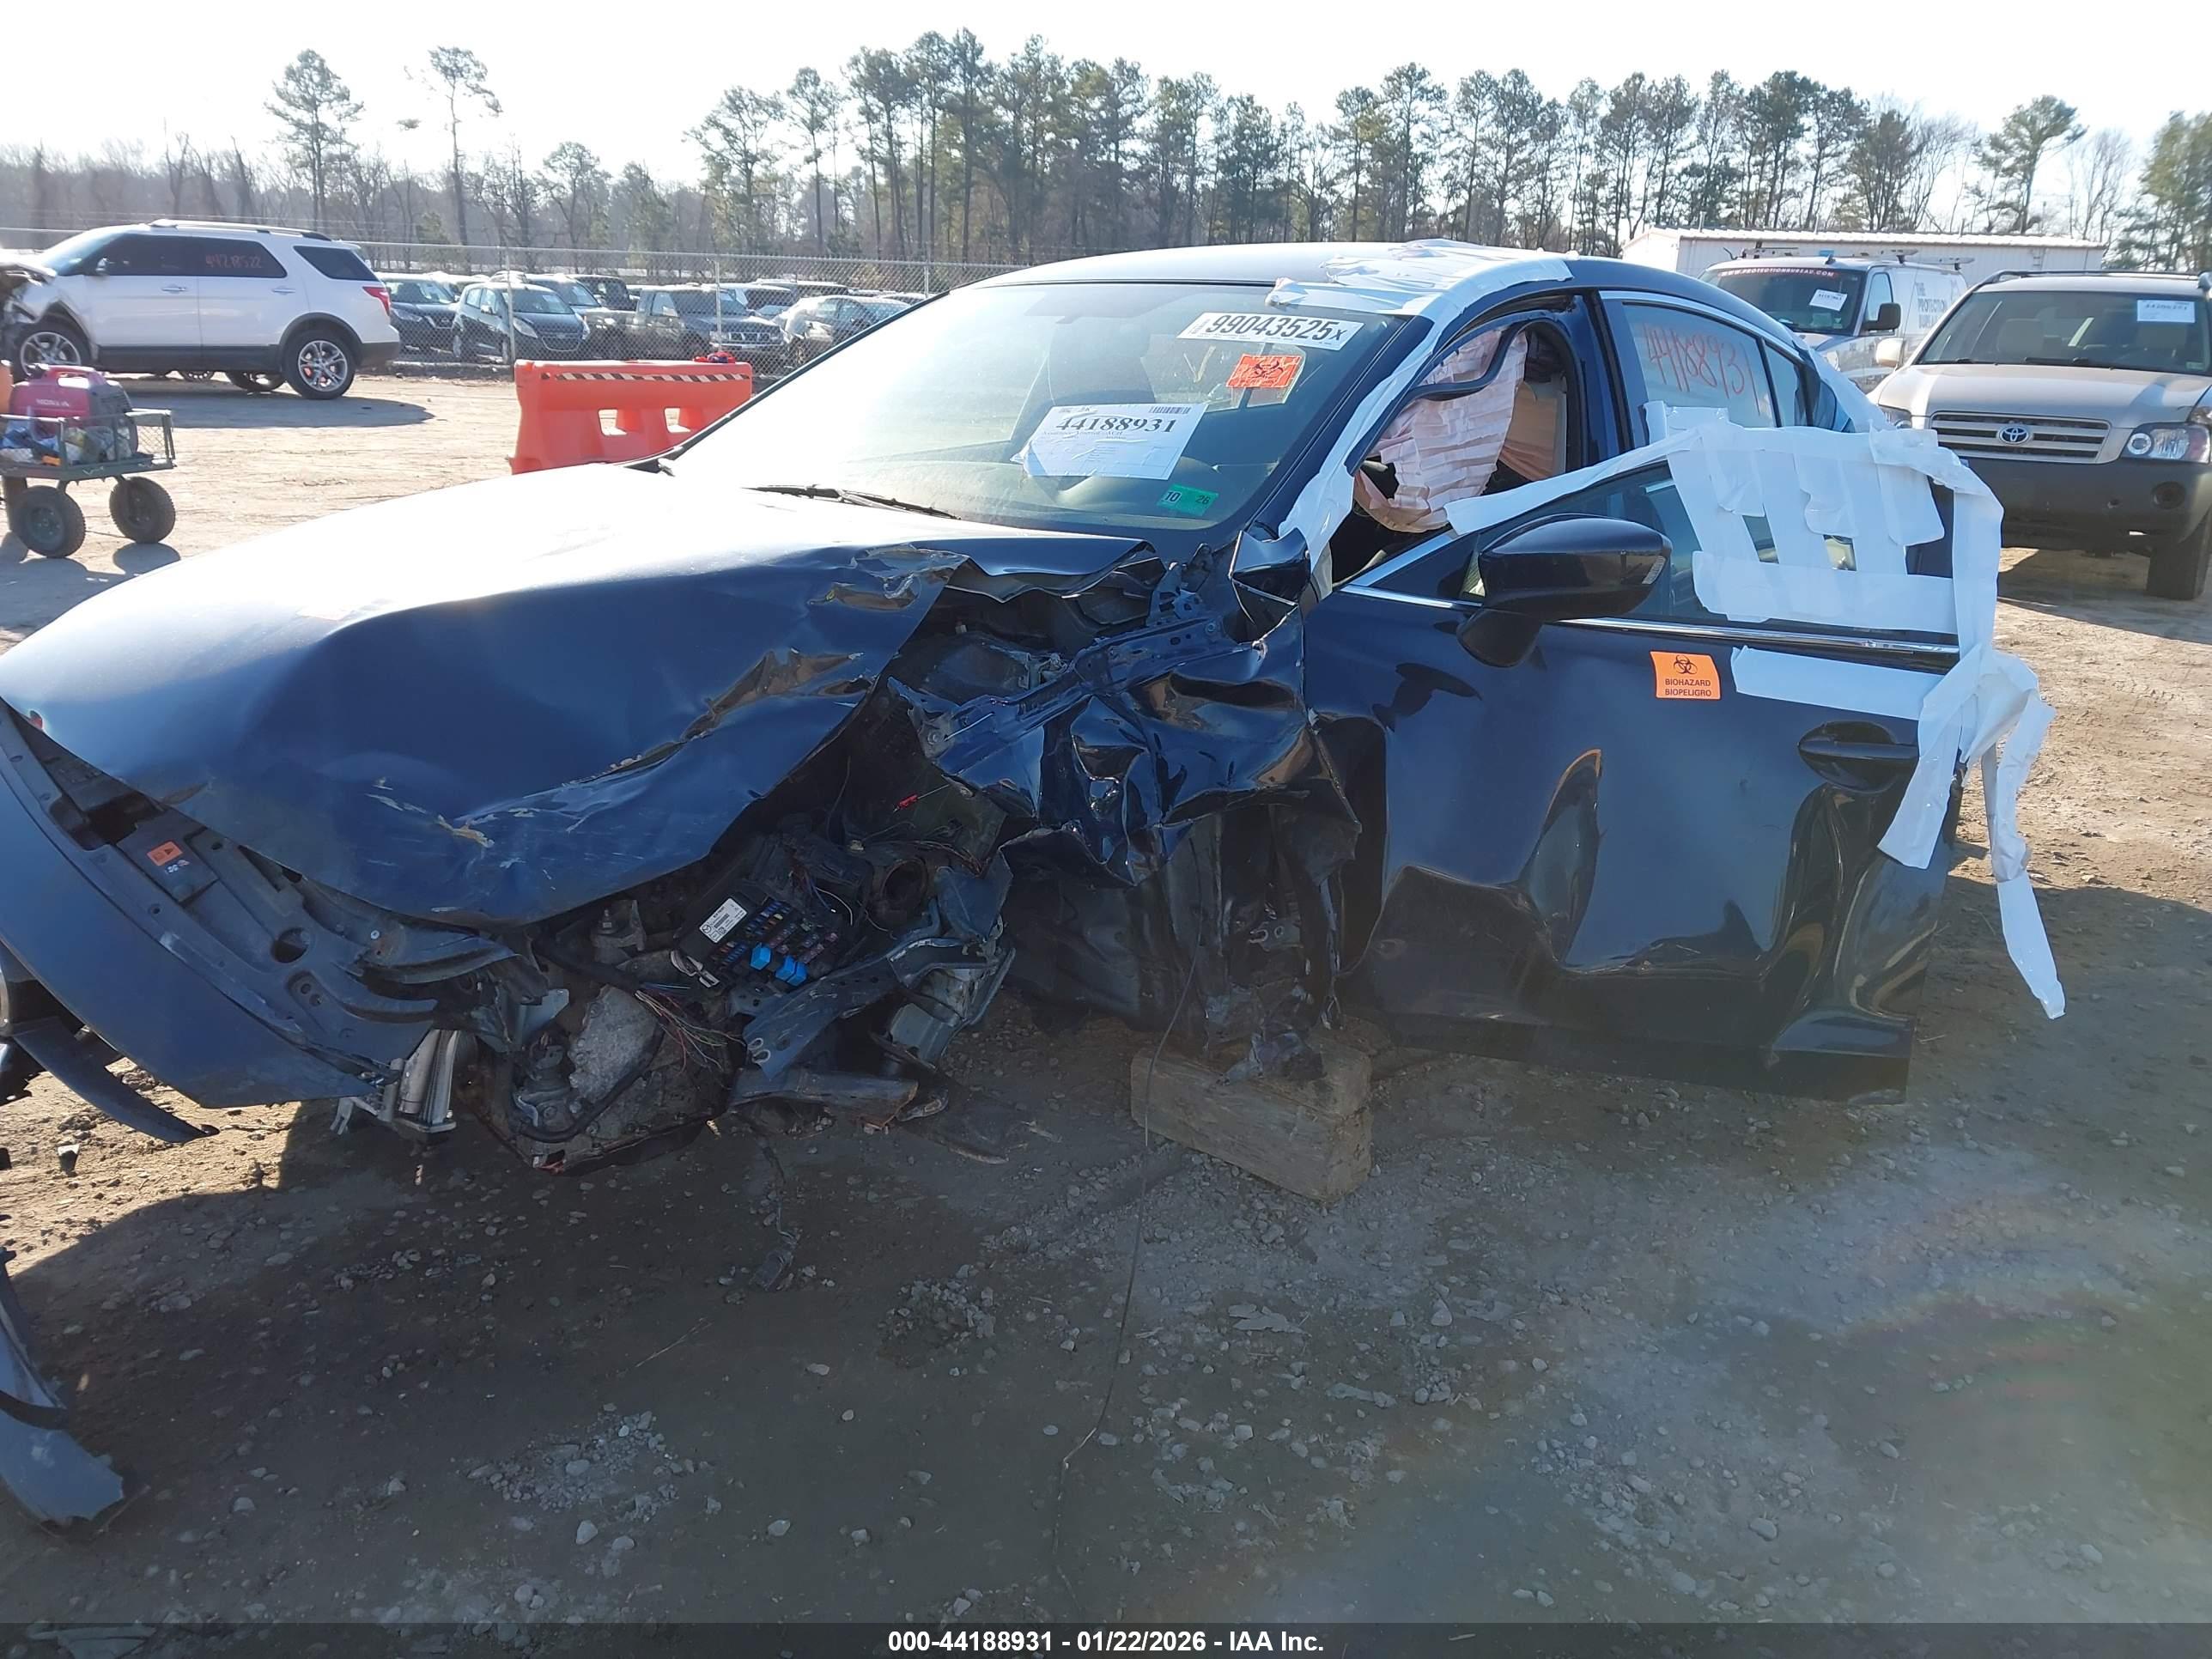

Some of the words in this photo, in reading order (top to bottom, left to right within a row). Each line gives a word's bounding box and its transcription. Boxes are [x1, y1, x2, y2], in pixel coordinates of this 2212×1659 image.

[1720, 266, 1835, 277] WWW.PROTECTIONBUREAU.COM
[1056, 416, 1177, 433] 44188931
[1164, 491, 1182, 502] 10
[1195, 495, 1211, 505] 26
[1664, 678, 1711, 687] BIOHAZARD
[1664, 688, 1712, 697] BIOPELIGRO
